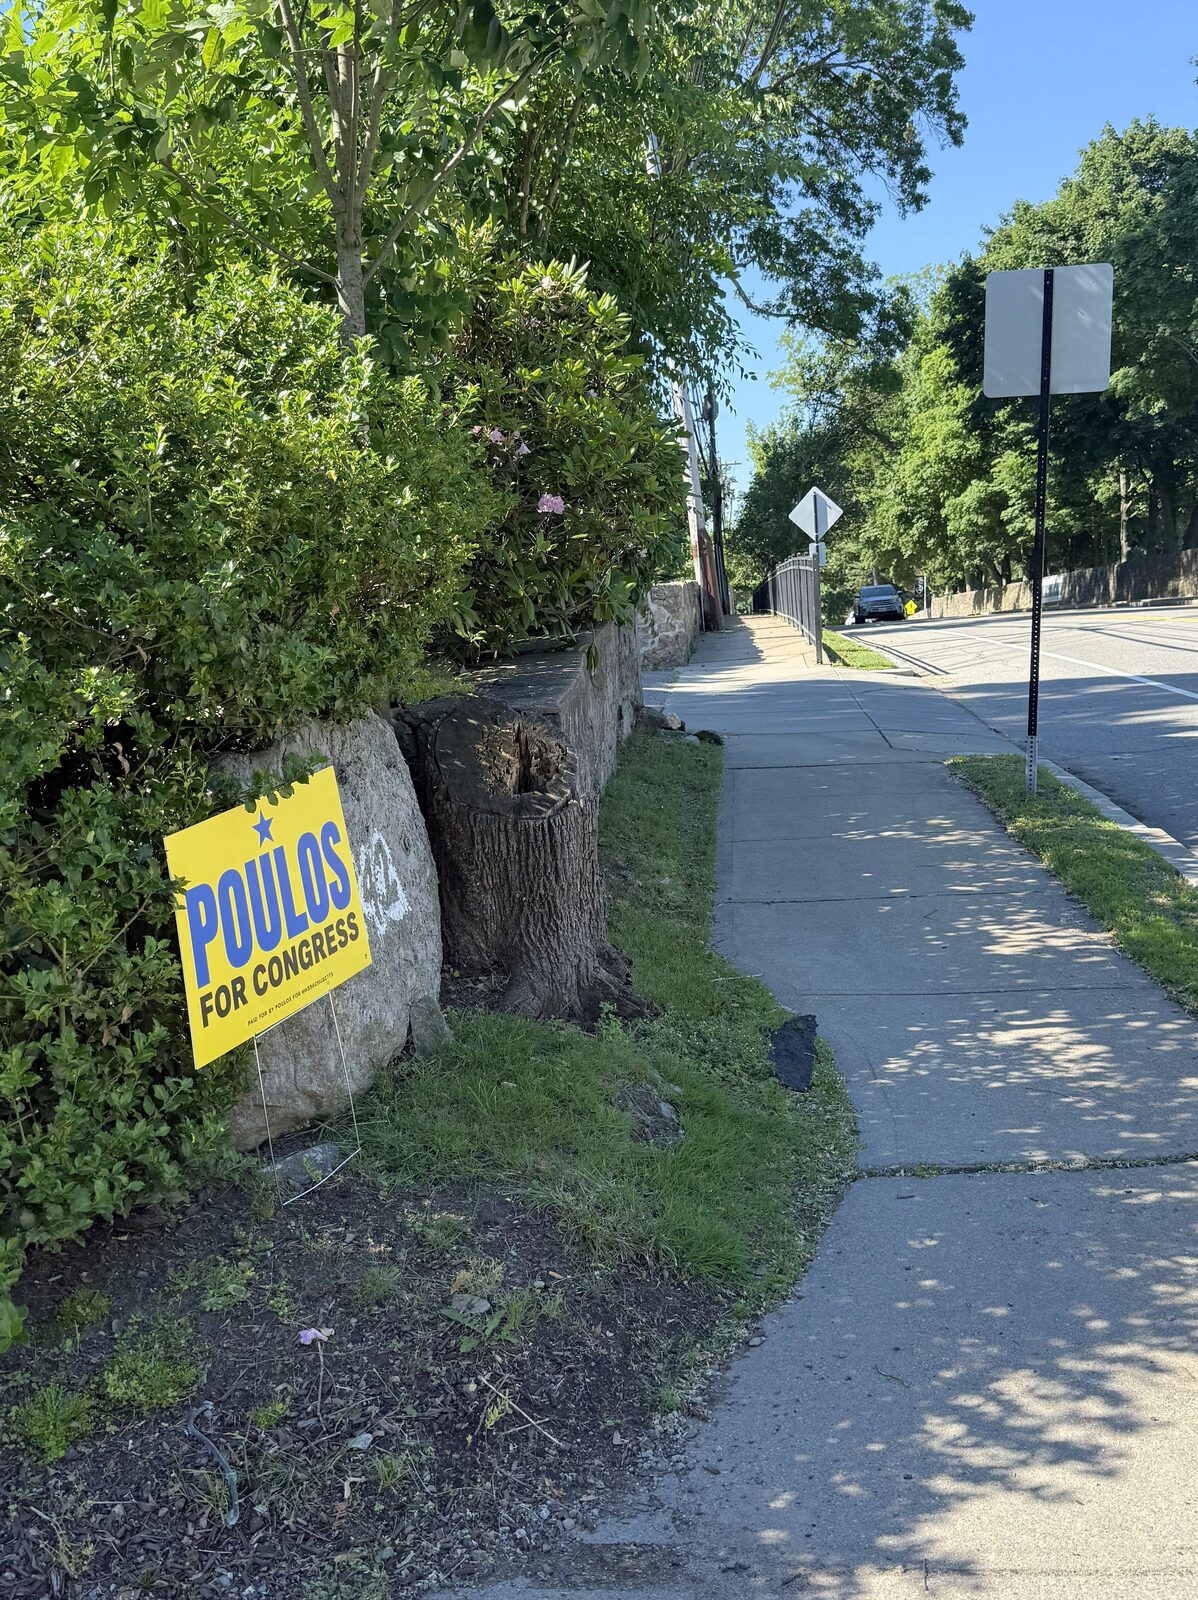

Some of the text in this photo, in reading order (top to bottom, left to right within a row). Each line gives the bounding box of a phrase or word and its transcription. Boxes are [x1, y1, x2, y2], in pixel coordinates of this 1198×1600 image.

[185, 821, 351, 989] POULOS
[199, 912, 359, 1028] FOR CONGRESS
[247, 1016, 258, 1026] PAID
[258, 1010, 268, 1020] FOR
[268, 1006, 275, 1014] BY
[275, 997, 292, 1009] POULOS
[292, 991, 301, 1000] FOR
